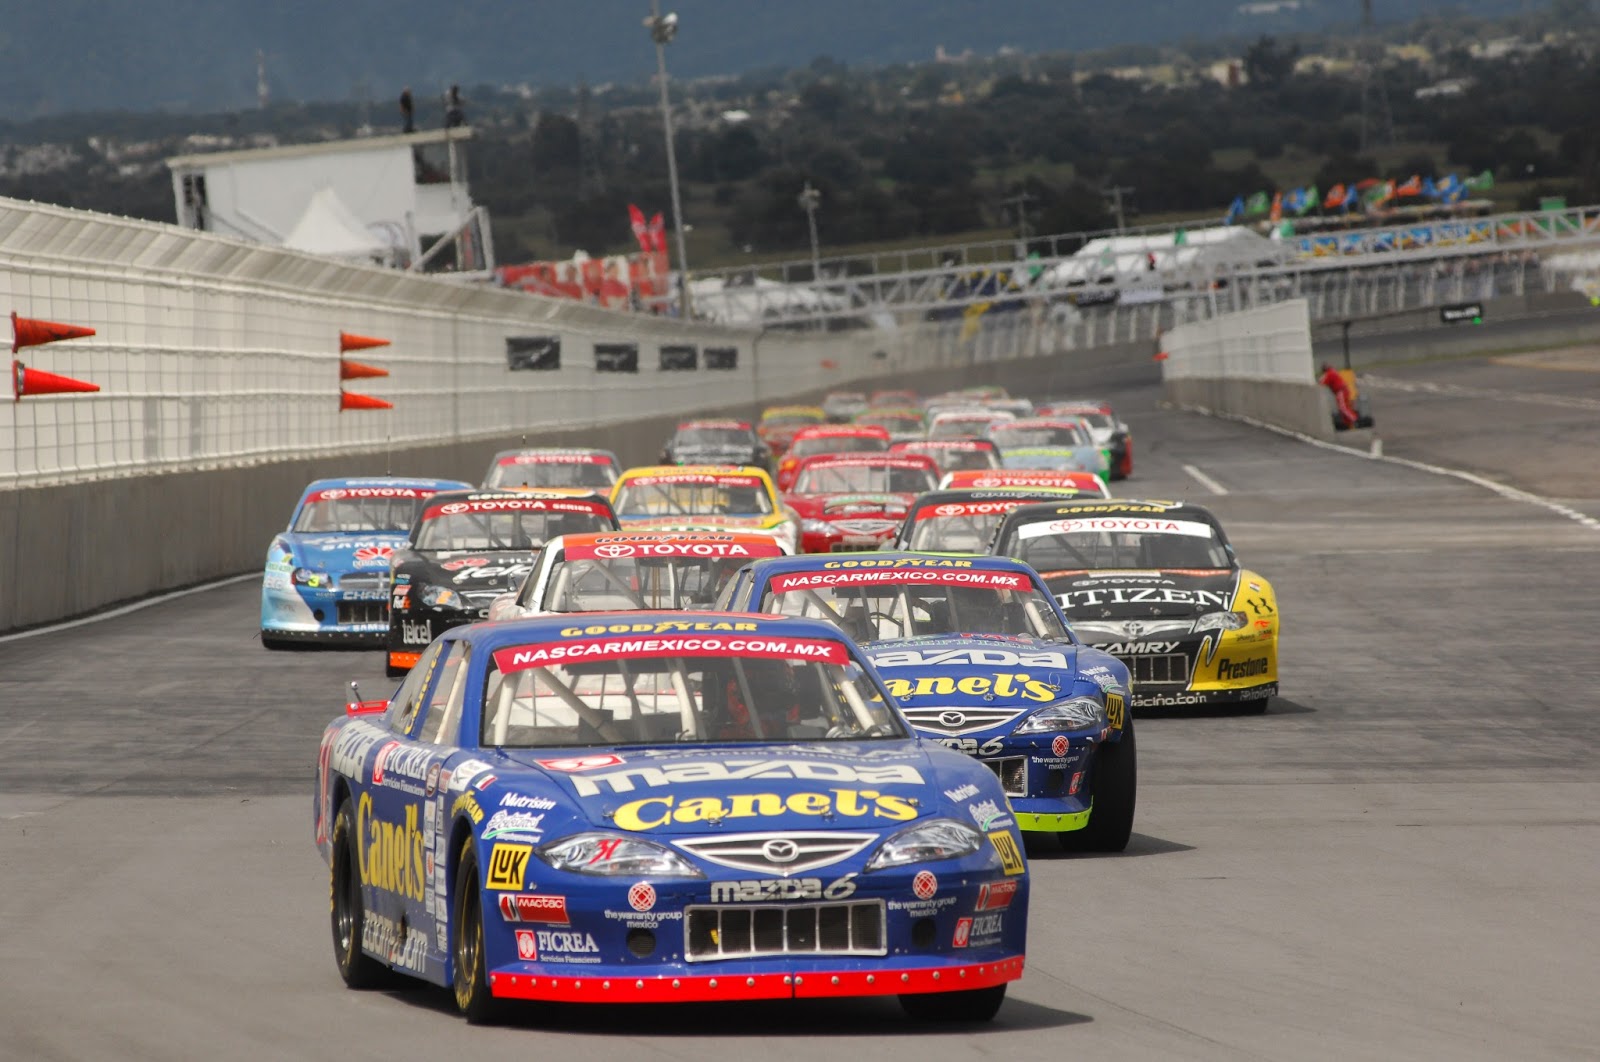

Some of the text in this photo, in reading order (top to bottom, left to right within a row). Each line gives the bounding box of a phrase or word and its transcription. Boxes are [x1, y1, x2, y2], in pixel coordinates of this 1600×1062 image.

[658, 475, 716, 483] TOYOTA
[1002, 478, 1077, 488] TOYOTA
[349, 488, 417, 497] TOYOTA
[470, 500, 593, 512] TOYOTA SERIES
[966, 502, 1026, 514] TOYO
[1056, 503, 1167, 515] GOODYEAR
[1086, 519, 1180, 531] TOYOTA
[594, 533, 736, 545] GOODYEAR
[321, 540, 412, 552] SAMSU
[638, 544, 750, 556] TOYOTA
[823, 557, 973, 569] GOODYEAR
[452, 564, 532, 582] telc
[782, 570, 1020, 589] NASCARMEXICO.COM.MX
[1098, 577, 1176, 586] TOYOTA
[342, 589, 390, 600] CHAR
[1053, 587, 1232, 611] ITIZEN
[352, 623, 390, 631] SAMS
[401, 619, 431, 645] telcel
[560, 620, 758, 638] GOODYEAR
[512, 639, 833, 665] NASCARMEXICO.COM.MX
[868, 649, 1069, 669] azda
[1217, 656, 1269, 680] Prestone
[882, 673, 1056, 702] anel's
[384, 743, 434, 781] FICREA
[613, 788, 919, 832] Canel's
[357, 791, 425, 903] Canel's
[491, 848, 527, 884] LUK
[888, 896, 957, 912] the warranty group
[604, 909, 683, 921] the warranty group
[909, 908, 938, 918] mexico
[626, 920, 659, 929] mexico
[970, 914, 1003, 937] FICREA
[536, 931, 600, 953] FICREA
[540, 954, 602, 964] Servicios Financieros
